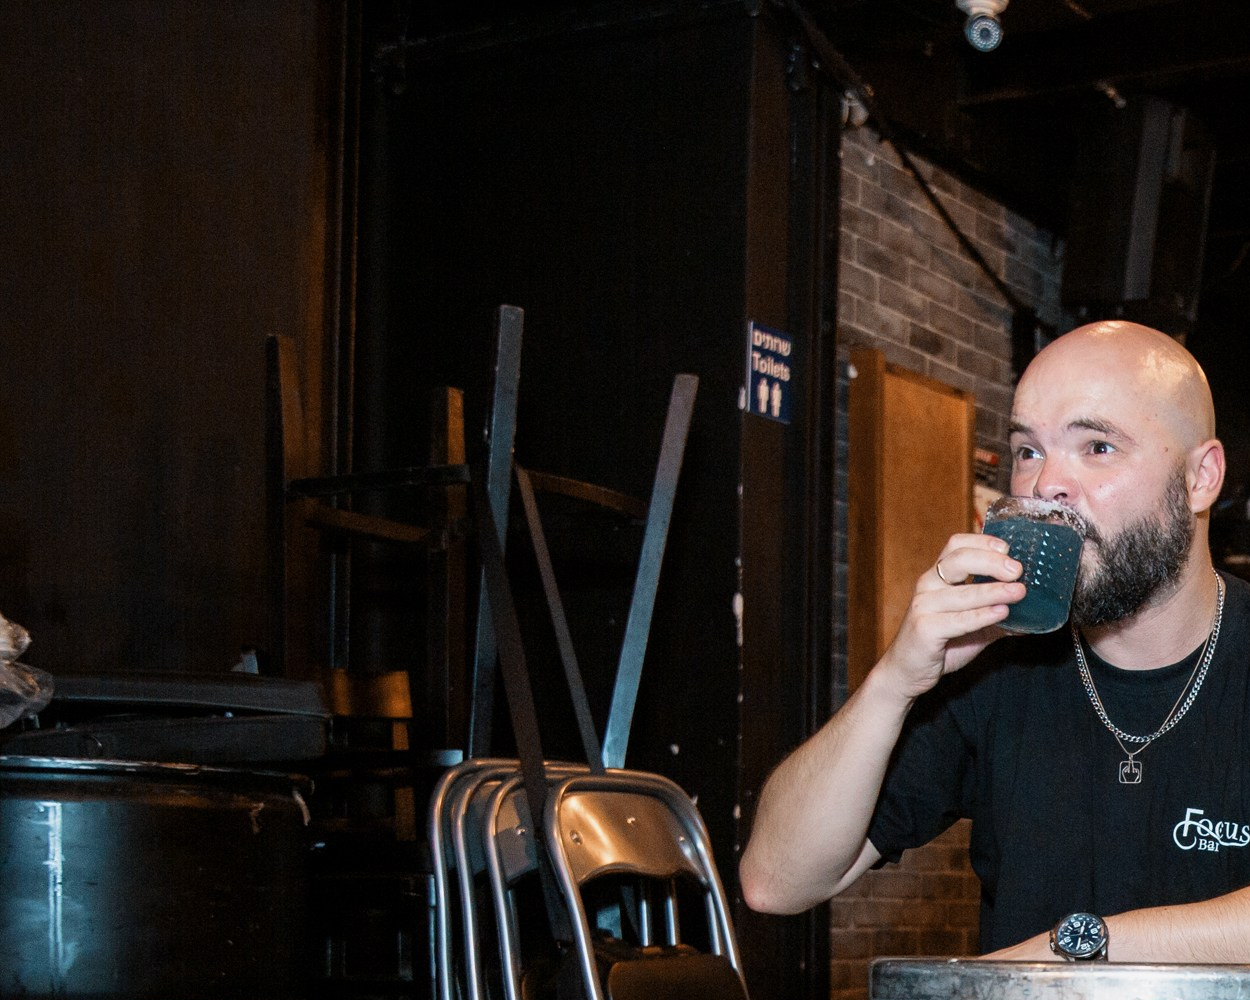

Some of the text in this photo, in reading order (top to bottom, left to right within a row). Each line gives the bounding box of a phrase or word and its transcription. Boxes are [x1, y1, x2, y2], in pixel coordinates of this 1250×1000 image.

[751, 351, 791, 382] Toilets
[1173, 807, 1250, 850] Focus
[1198, 838, 1220, 852] Bar
